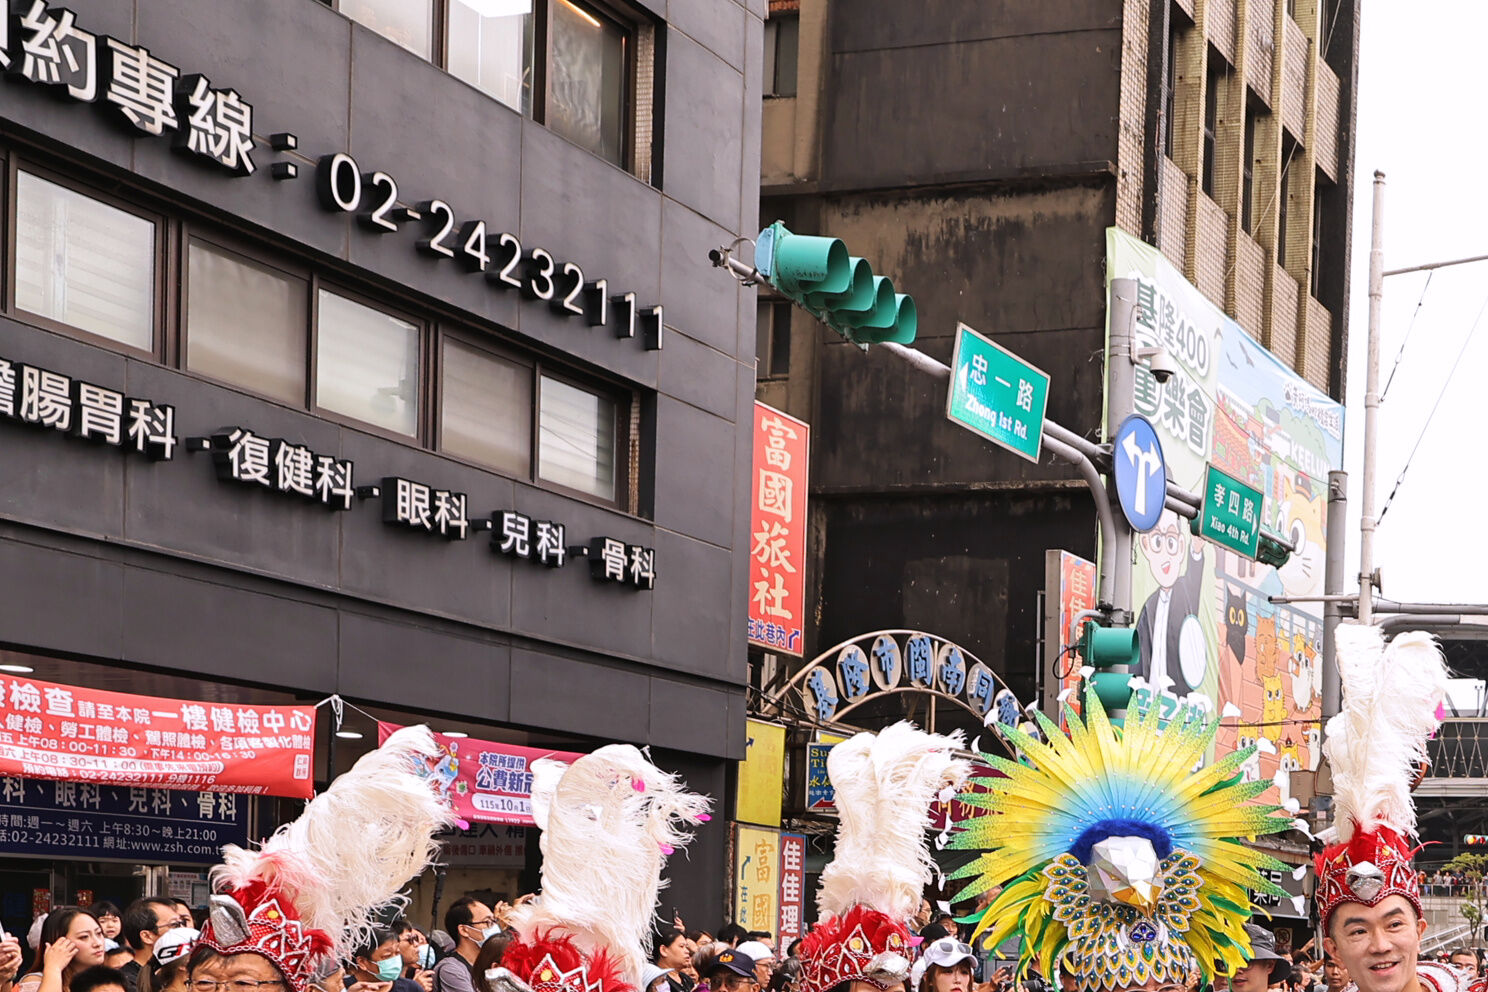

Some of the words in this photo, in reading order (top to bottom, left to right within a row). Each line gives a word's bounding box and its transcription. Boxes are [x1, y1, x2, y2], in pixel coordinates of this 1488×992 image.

[970, 353, 1035, 413] 忠一路
[965, 393, 998, 428] Zhong
[1013, 419, 1029, 441] Rd.
[752, 415, 798, 622] 富國旅社
[1210, 514, 1226, 534] Xiao
[1226, 523, 1240, 540] 4th
[1240, 529, 1250, 546] Rd.
[1214, 482, 1254, 524] 孝四路
[0, 679, 313, 734] 檢查請至本院一樓健檢中心
[806, 636, 1032, 736] 基隆市閩南同鄉
[103, 838, 223, 857] 網址:www.zsh.com.t
[752, 838, 774, 931] 富國
